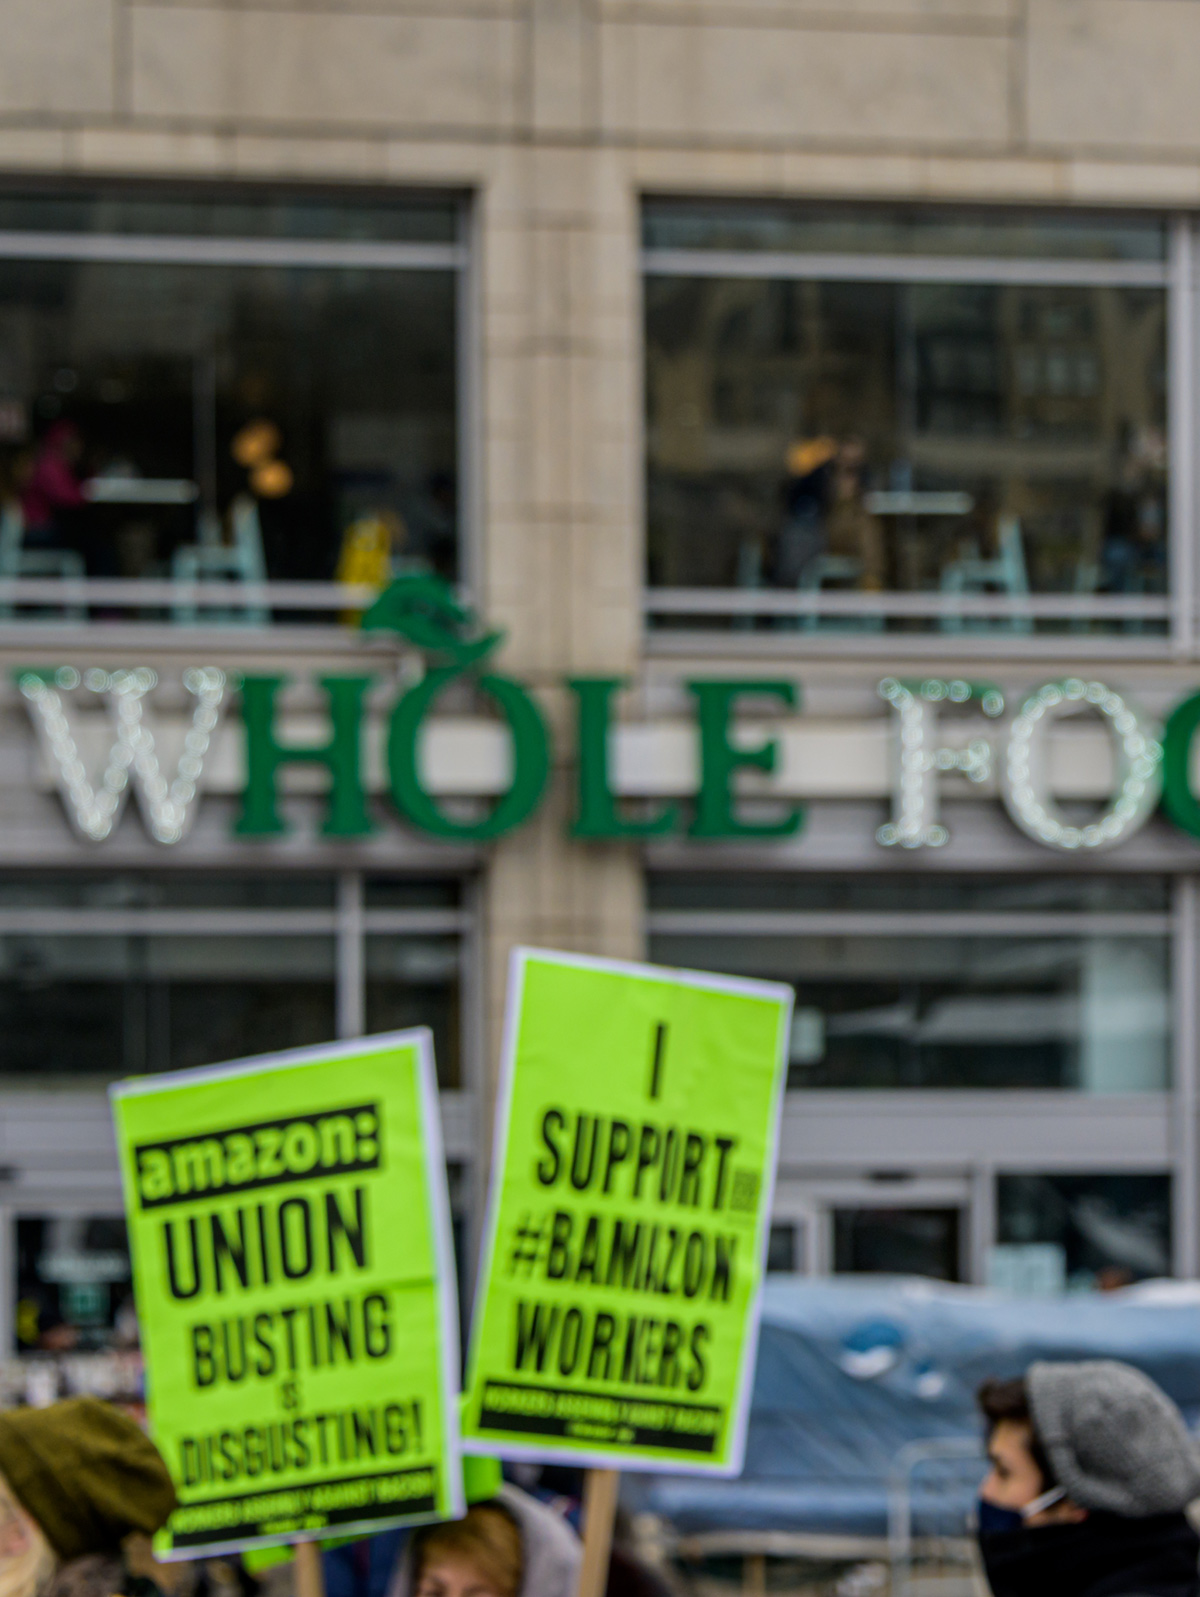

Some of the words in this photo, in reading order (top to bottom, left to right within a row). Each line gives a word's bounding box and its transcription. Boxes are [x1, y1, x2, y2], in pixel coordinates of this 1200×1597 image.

[14, 662, 806, 843] WHOLE
[648, 1021, 668, 1100] I
[138, 1111, 378, 1200] amazon:
[537, 1109, 735, 1210] SUPPORT
[163, 1187, 367, 1300] UNION
[190, 1293, 393, 1388] BUSTING
[514, 1302, 712, 1391] WORKERS
[181, 1401, 423, 1486] DISGUSTING!
